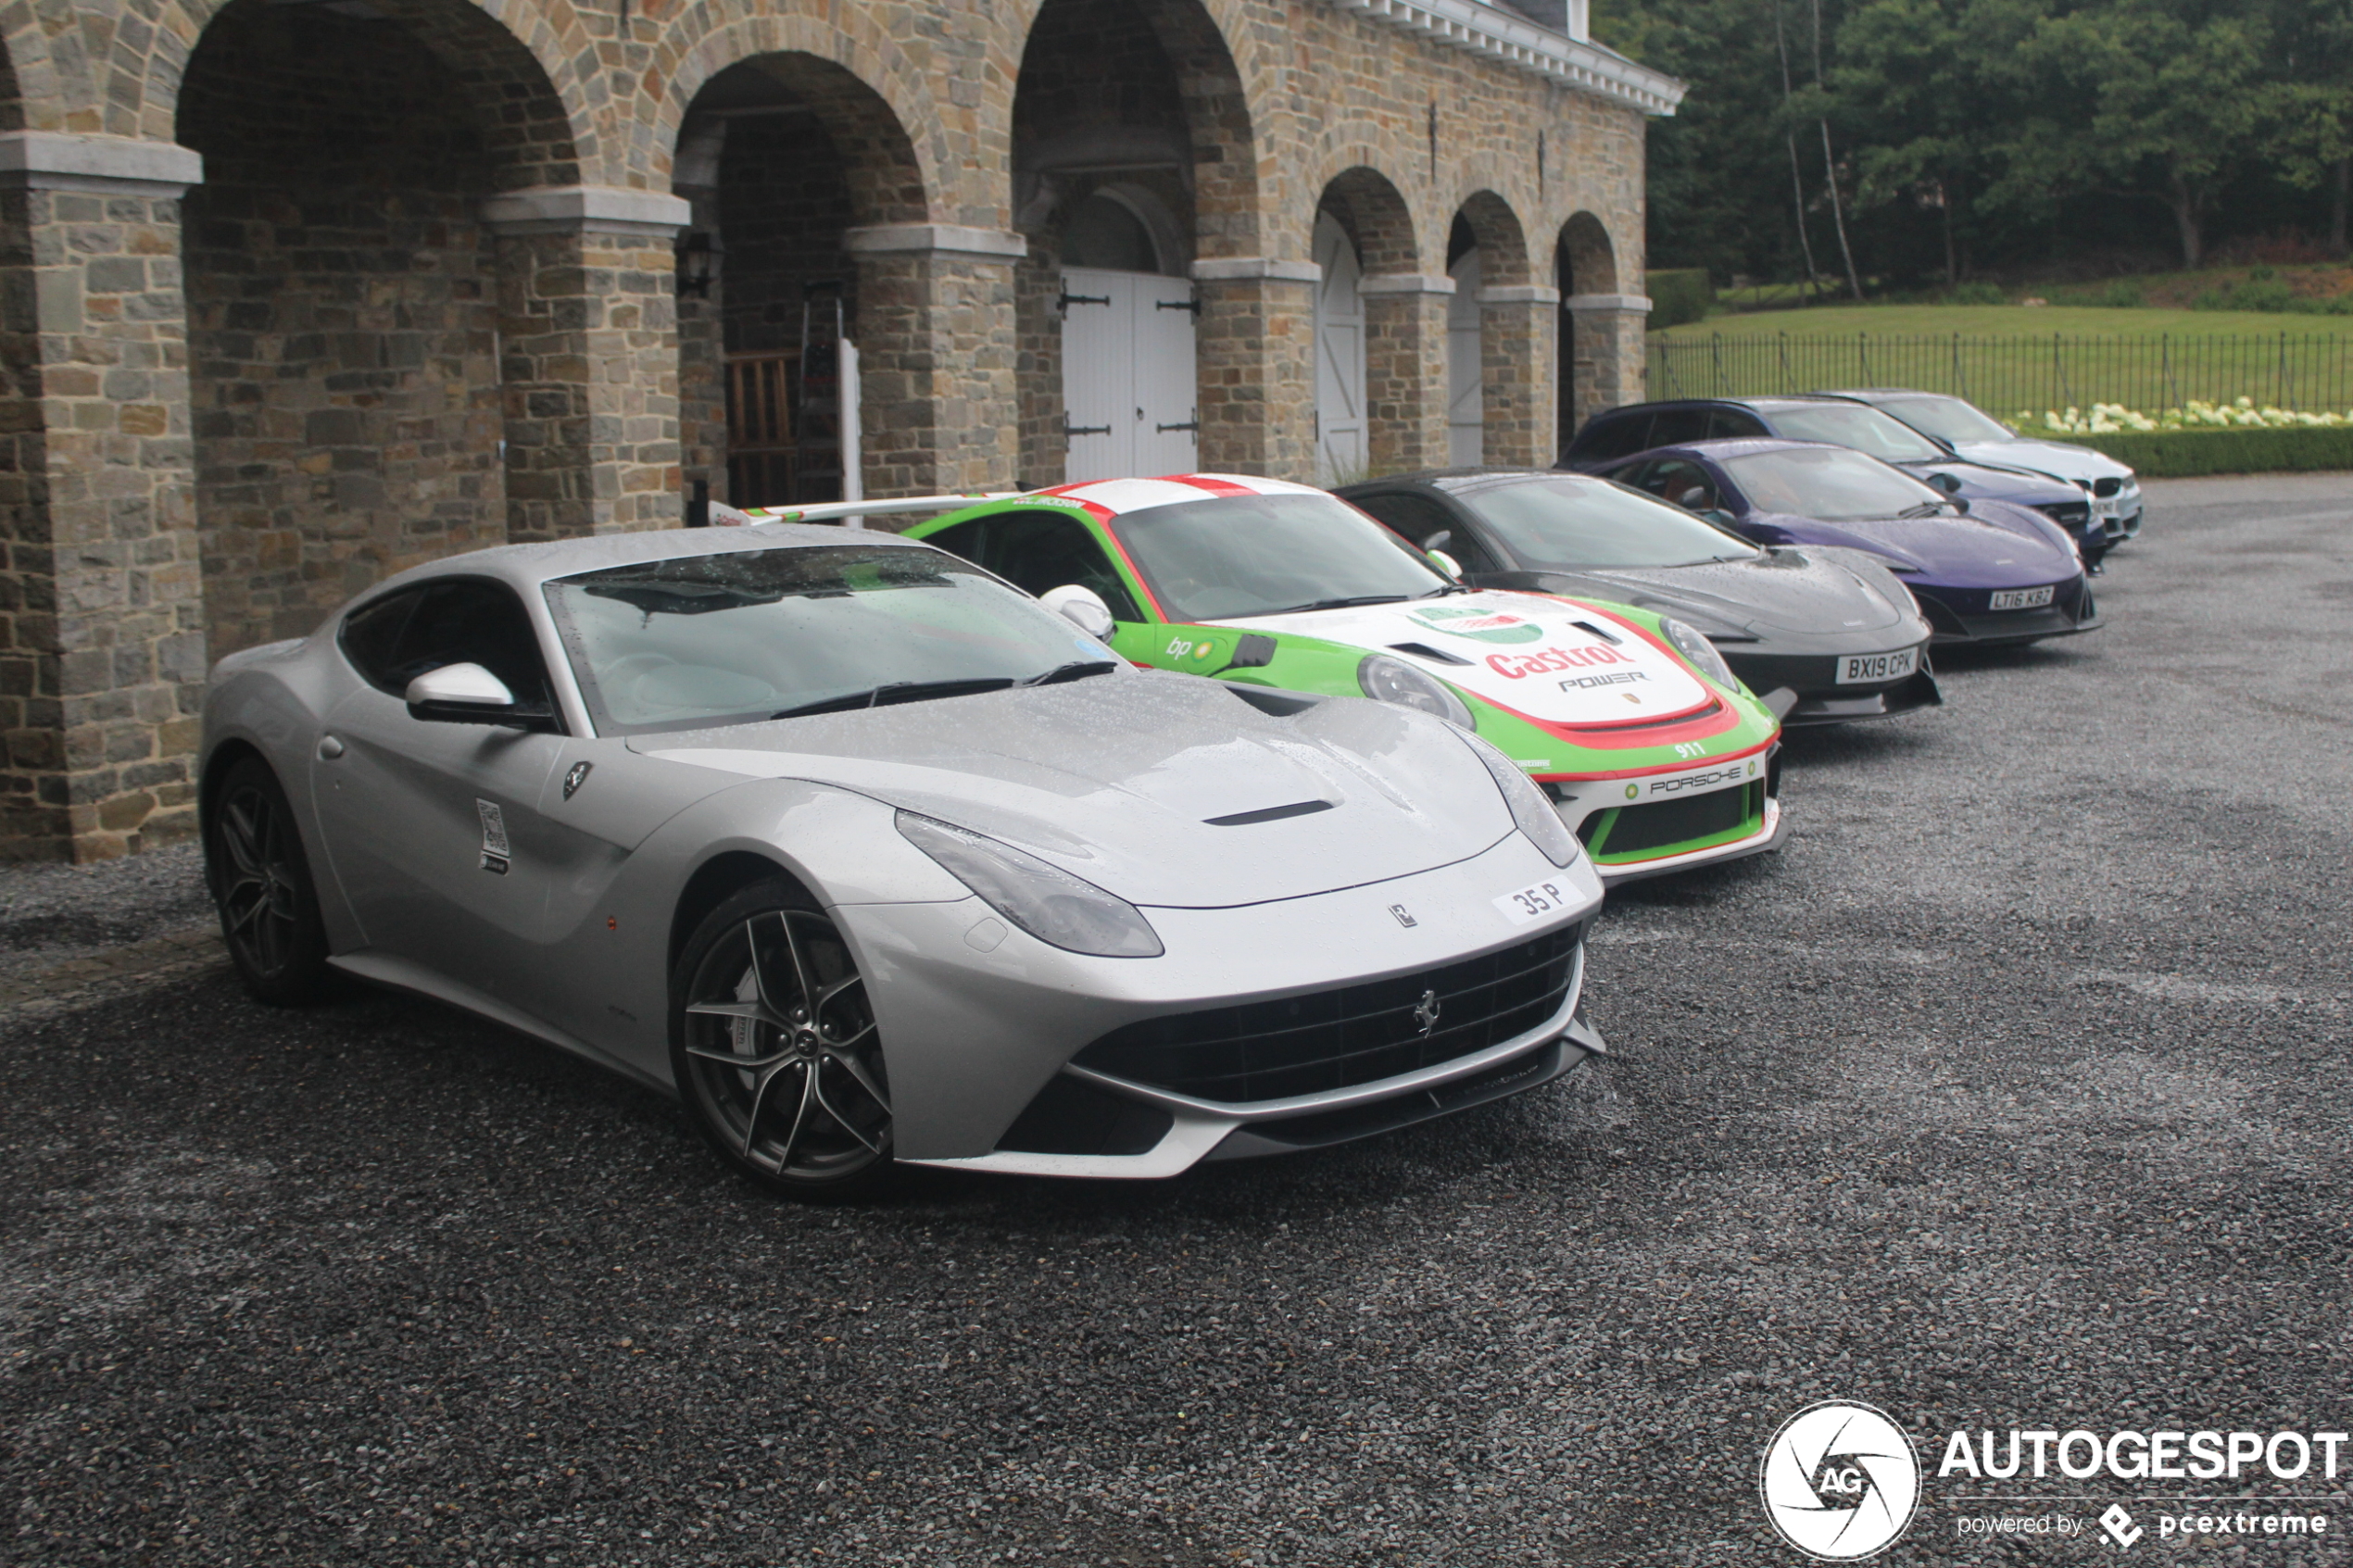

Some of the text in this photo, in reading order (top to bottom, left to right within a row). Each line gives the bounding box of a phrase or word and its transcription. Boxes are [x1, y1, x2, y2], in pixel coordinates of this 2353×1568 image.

[1994, 594, 2023, 608] LT16
[1165, 636, 1192, 660] bp
[1485, 642, 1636, 680] Castrol
[1848, 652, 1912, 679] BX19 CPK
[1557, 671, 1652, 693] POWER
[1674, 742, 1706, 759] 911
[1650, 767, 1741, 795] PORSCHE
[1513, 884, 1563, 915] 35 P
